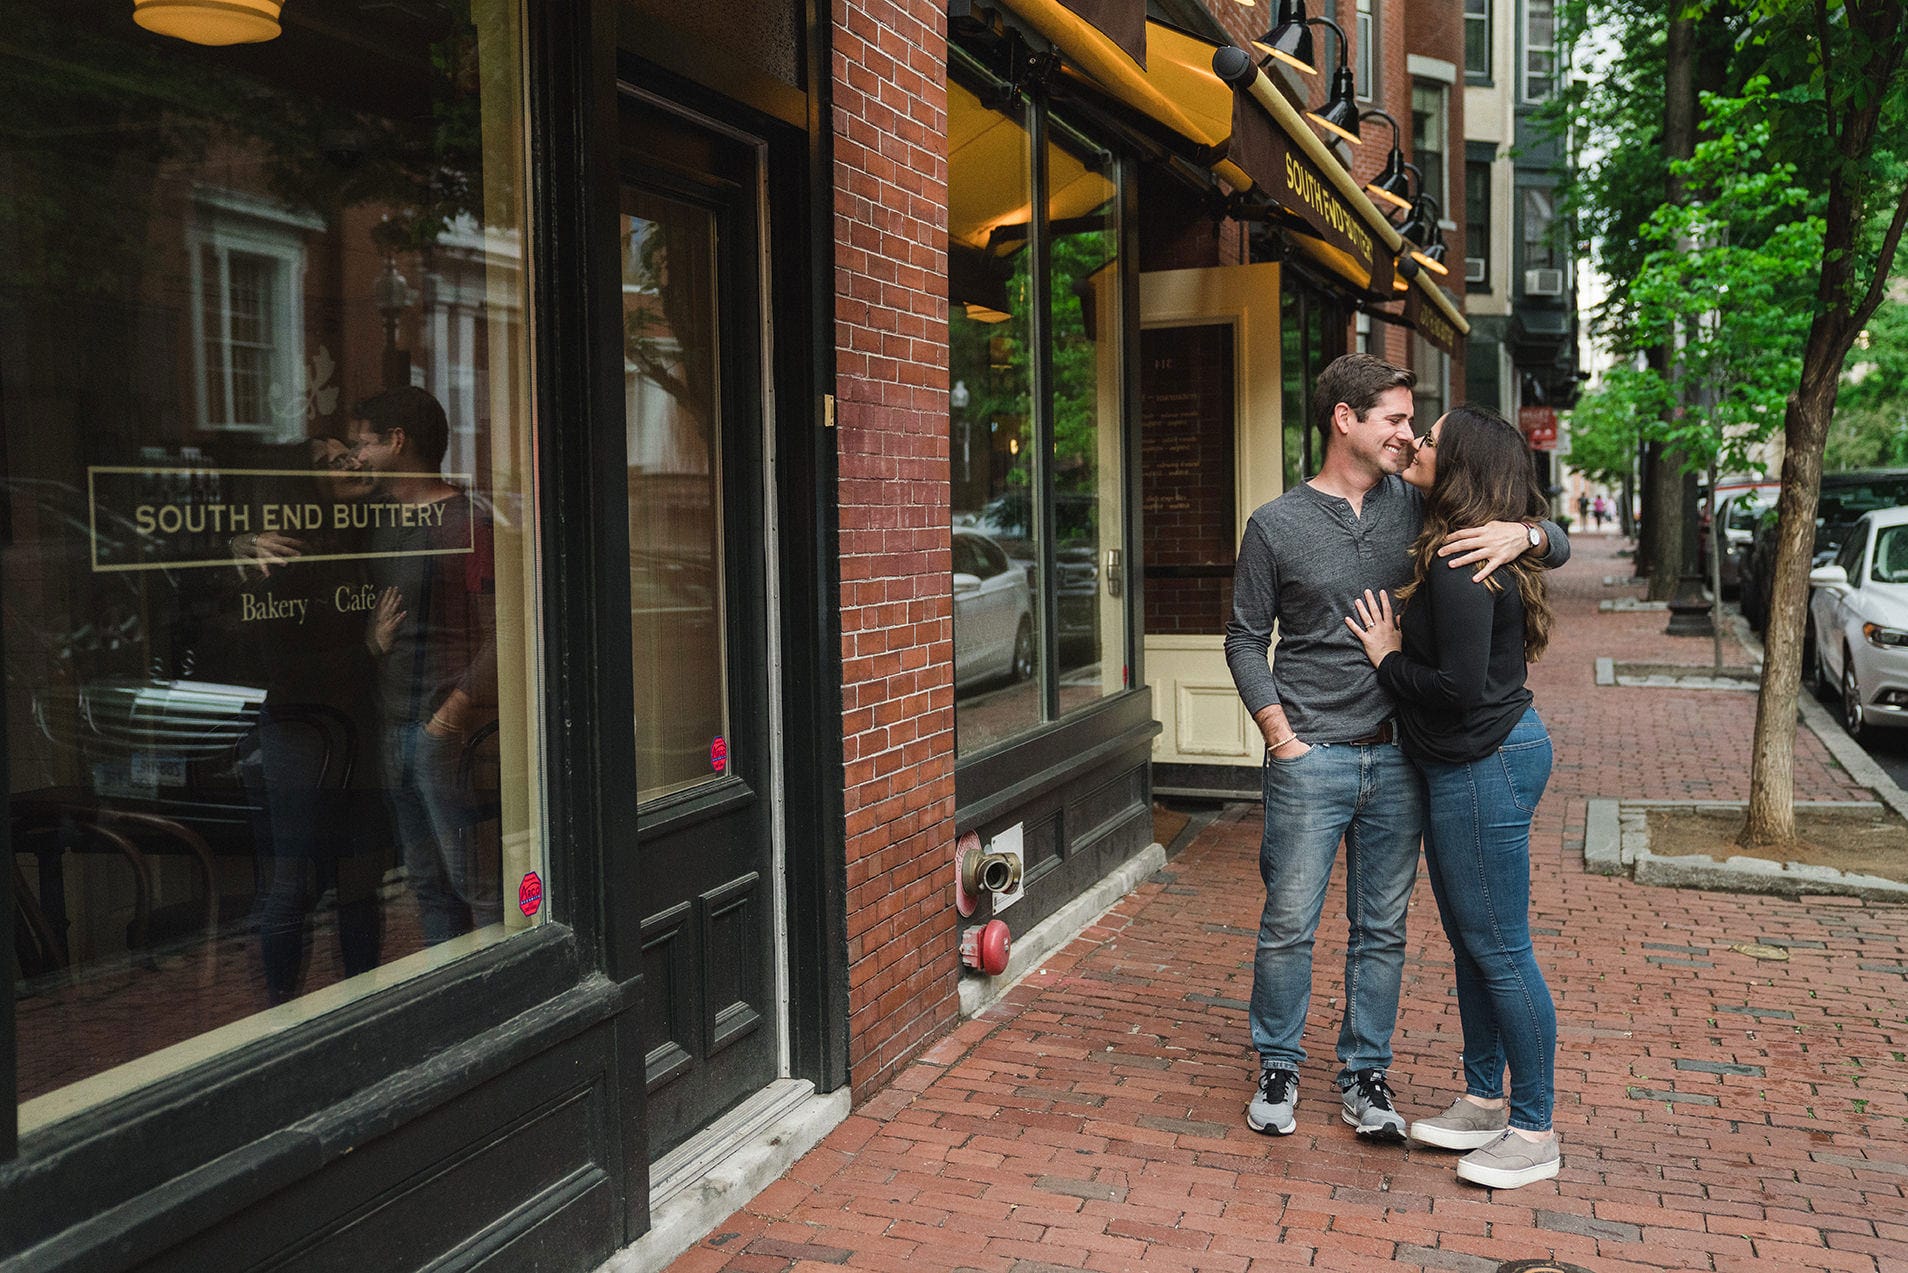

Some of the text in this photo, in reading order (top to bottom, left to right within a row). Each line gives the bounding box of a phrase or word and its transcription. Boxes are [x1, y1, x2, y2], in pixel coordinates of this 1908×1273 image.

[1285, 151, 1324, 216] SOUTH
[1323, 189, 1344, 233] END
[135, 503, 447, 534] SOUTH END BUTTERY
[241, 585, 376, 624] Bakery Café
